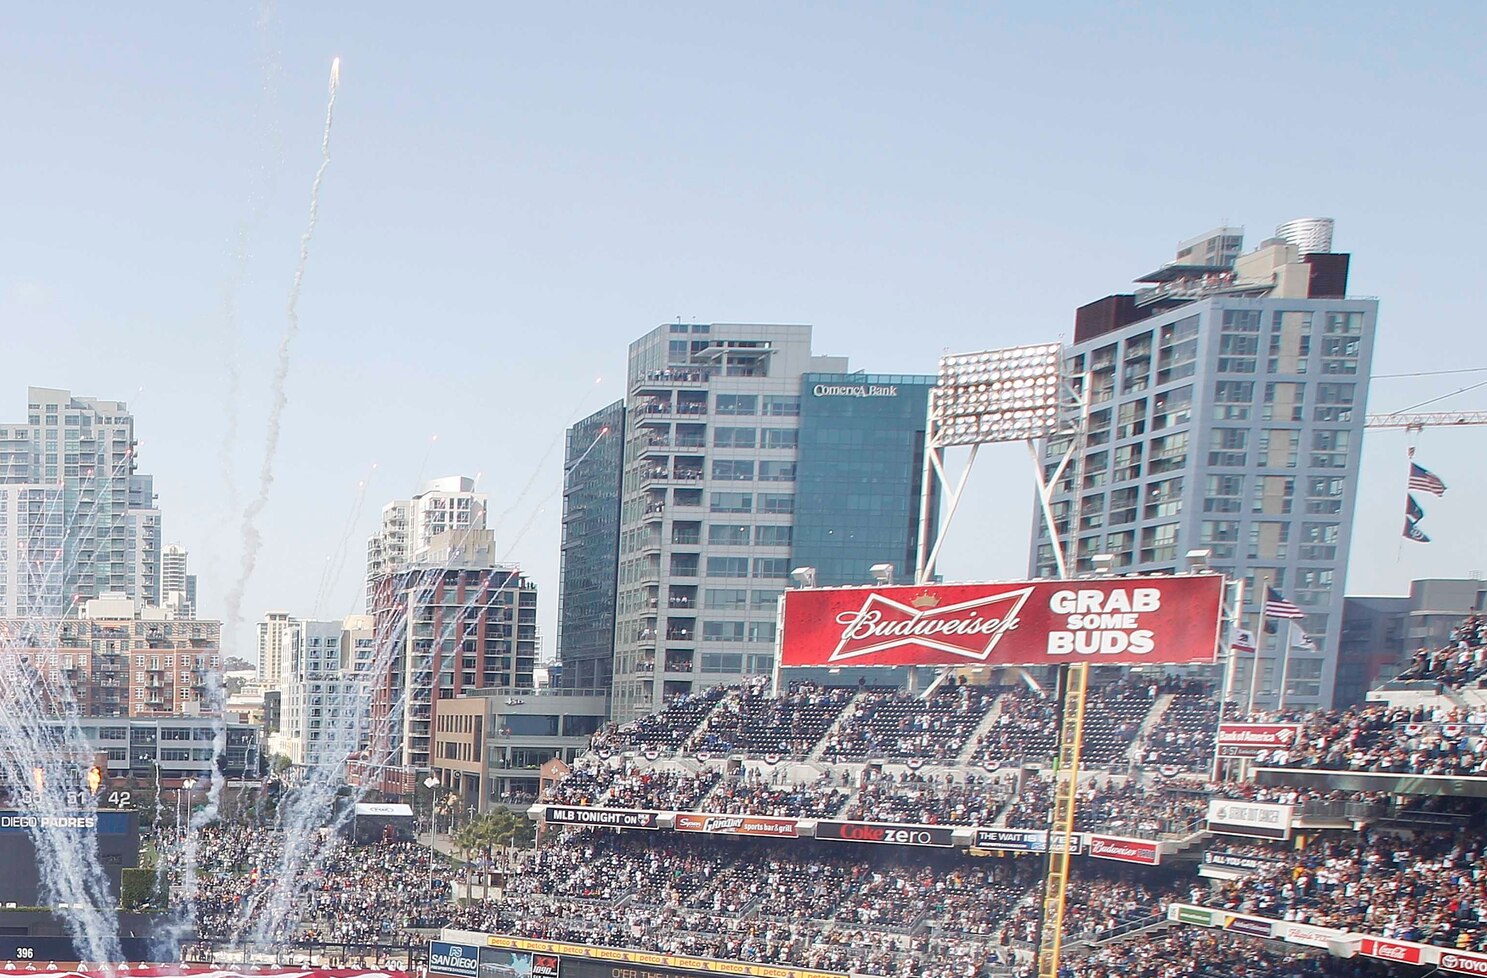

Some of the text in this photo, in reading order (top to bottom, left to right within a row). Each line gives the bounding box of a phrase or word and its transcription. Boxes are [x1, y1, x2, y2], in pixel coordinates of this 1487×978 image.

[869, 386, 897, 396] Bank
[1050, 588, 1160, 613] GRAB
[836, 611, 1019, 641] Budweiser
[1066, 614, 1138, 630] SOME
[1047, 630, 1154, 656] BUDS
[109, 792, 131, 805] 42
[553, 810, 574, 821] MLB
[577, 811, 621, 823] TONIGHT
[624, 815, 637, 824] ON
[2, 817, 37, 827] DIEGO
[41, 817, 94, 828] PADRES
[744, 823, 763, 832] sports
[840, 823, 931, 844] Coke zero
[979, 832, 1036, 842] THE WAIT IS
[1092, 840, 1137, 855] Budweiser
[492, 938, 510, 946] petco
[527, 942, 546, 950] petco
[17, 948, 33, 958] 396
[563, 946, 583, 955] petco
[601, 950, 621, 959] petco
[432, 955, 477, 970] SAN DIEGO
[639, 955, 660, 964] petco
[679, 959, 701, 968] petco
[1459, 958, 1487, 971] TOYO
[533, 966, 551, 974] 1090
[721, 963, 743, 973] petco
[764, 968, 787, 978] petco
